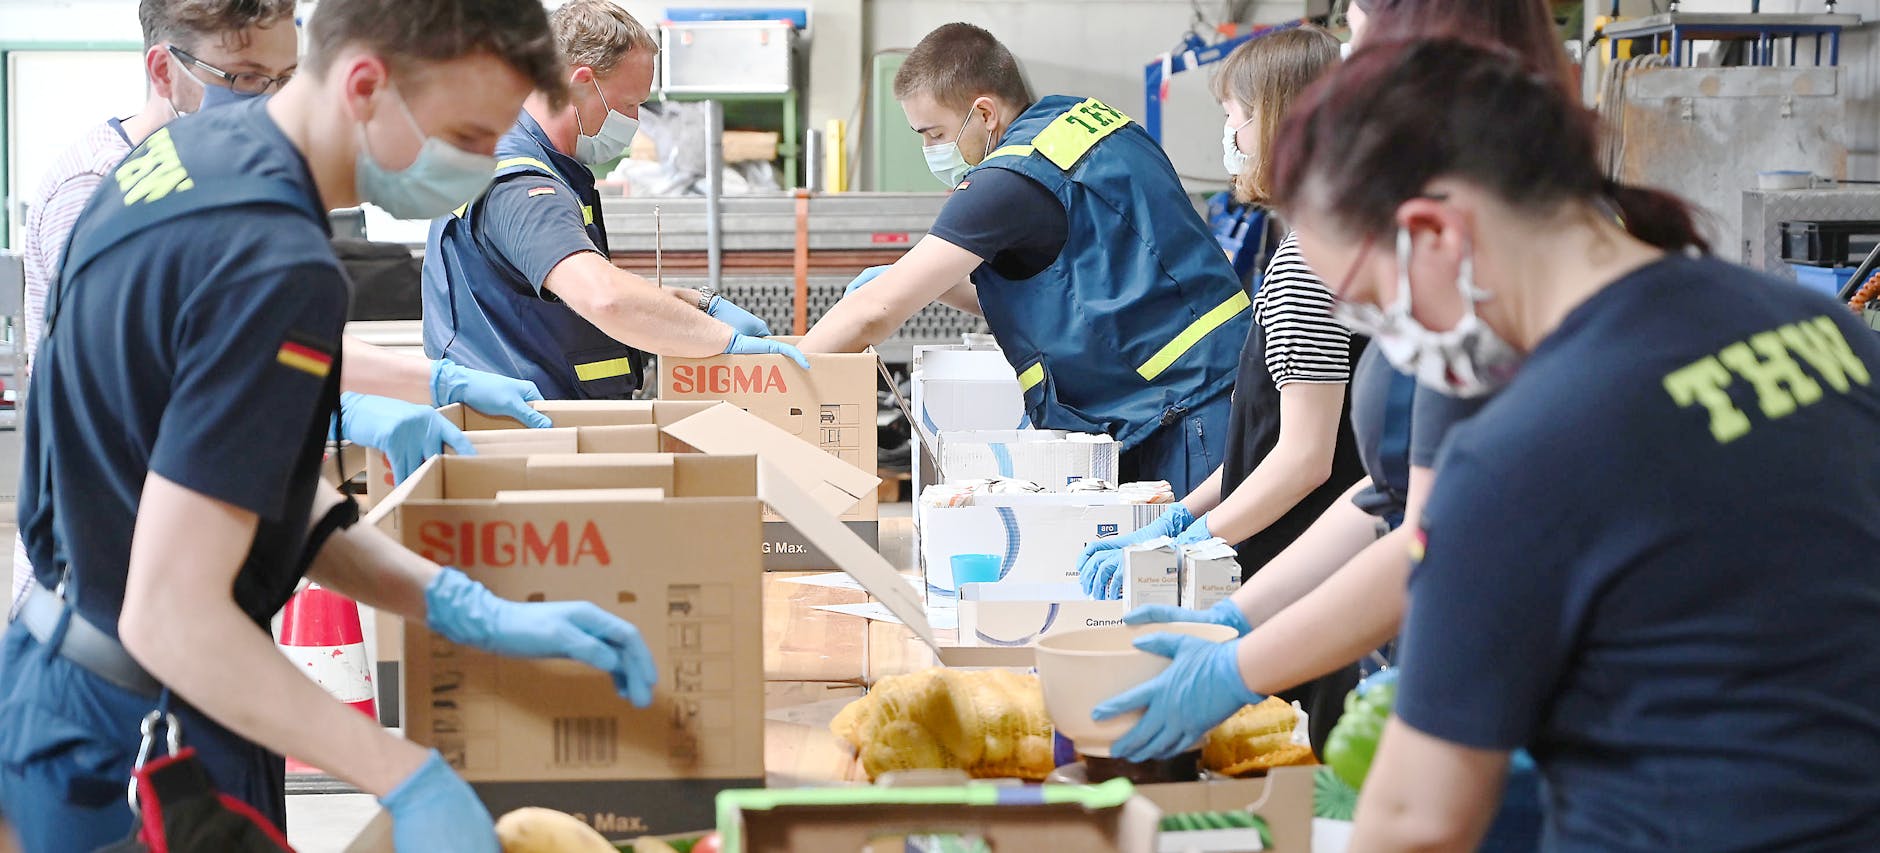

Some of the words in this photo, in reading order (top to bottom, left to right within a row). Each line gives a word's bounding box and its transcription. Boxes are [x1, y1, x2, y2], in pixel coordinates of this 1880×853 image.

[672, 365, 787, 394] SIGMA
[1662, 315, 1870, 444] THW
[418, 519, 612, 568] SIGMA
[775, 542, 807, 554] Max.
[1086, 618, 1123, 627] Canned
[594, 812, 649, 832] Max.
